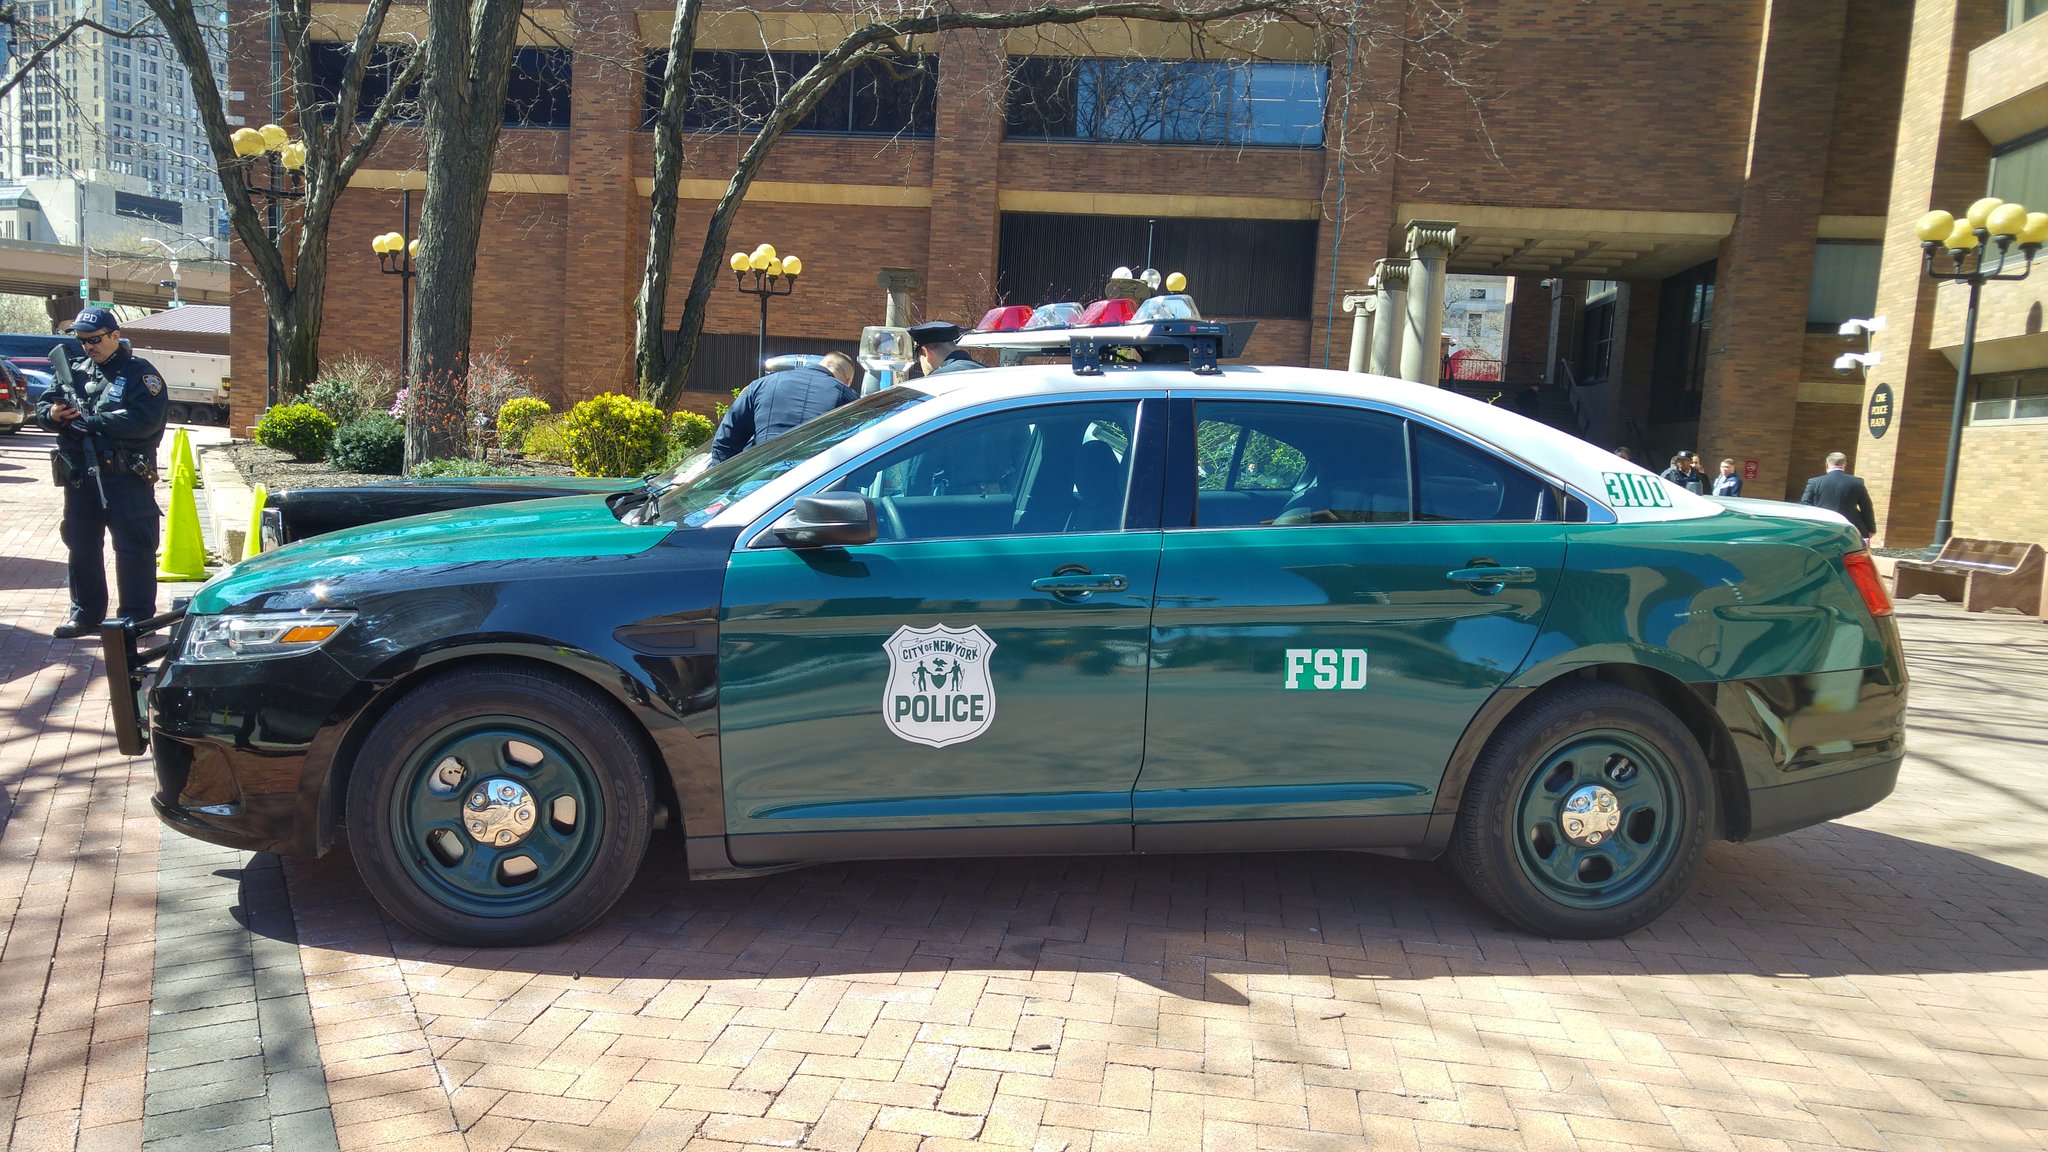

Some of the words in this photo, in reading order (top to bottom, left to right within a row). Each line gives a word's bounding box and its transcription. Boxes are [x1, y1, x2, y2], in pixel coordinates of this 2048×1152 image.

[1602, 472, 1672, 507] 3100
[903, 644, 925, 660] CITY
[924, 642, 933, 652] OF
[933, 640, 955, 652] NEW
[955, 645, 978, 661] YORK
[1285, 648, 1368, 690] FSD
[895, 694, 984, 723] POLICE
